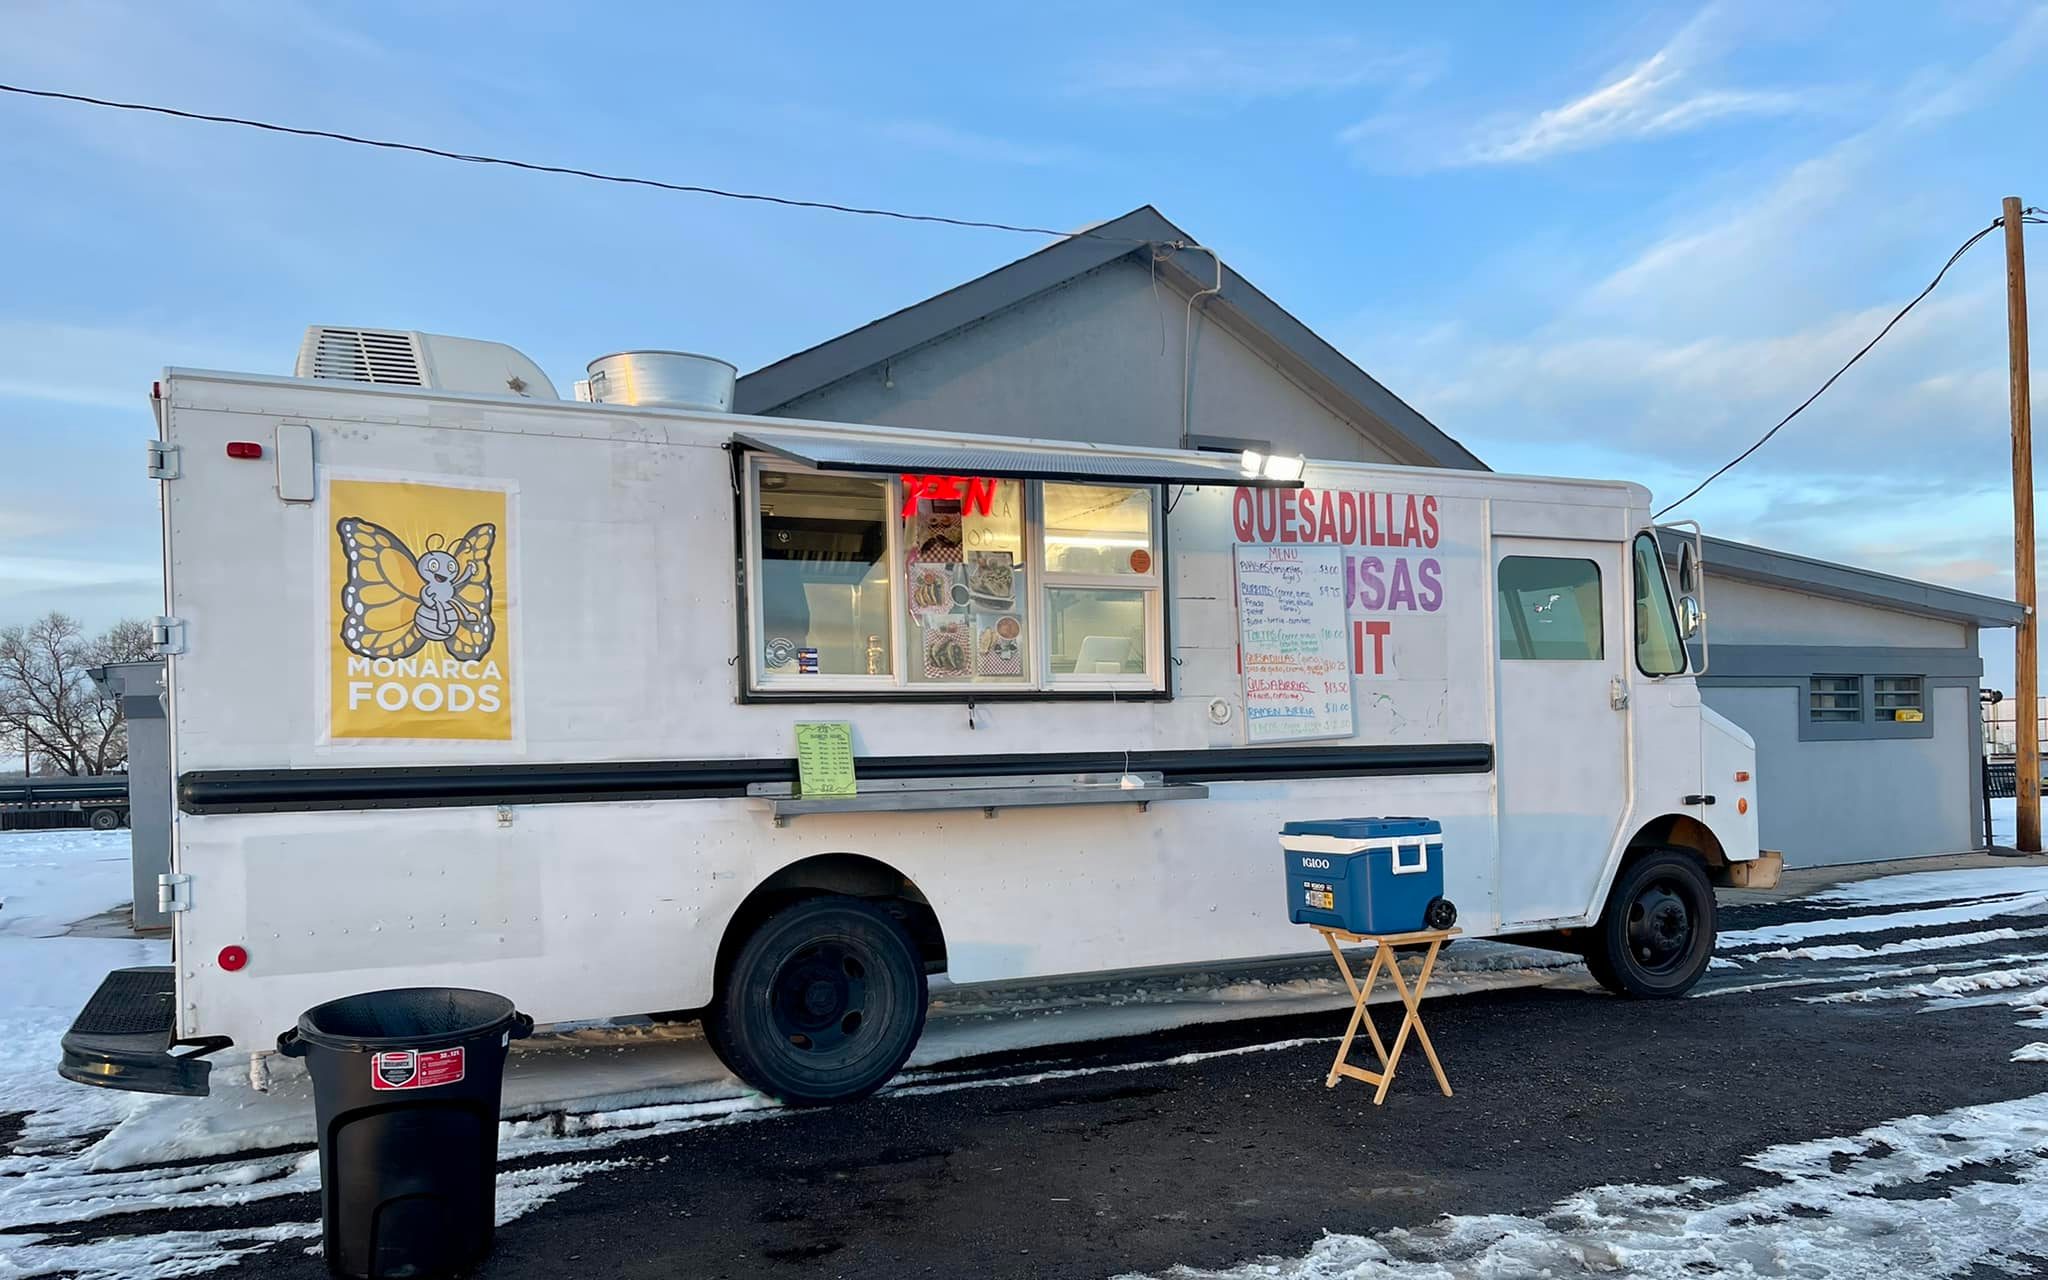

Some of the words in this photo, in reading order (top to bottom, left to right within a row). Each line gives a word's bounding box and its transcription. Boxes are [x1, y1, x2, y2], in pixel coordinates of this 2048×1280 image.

[1232, 486, 1440, 549] QUESADILLAS
[347, 656, 502, 680] MONARCA
[348, 681, 501, 712] FOODS
[1302, 857, 1330, 869] IGLOO
